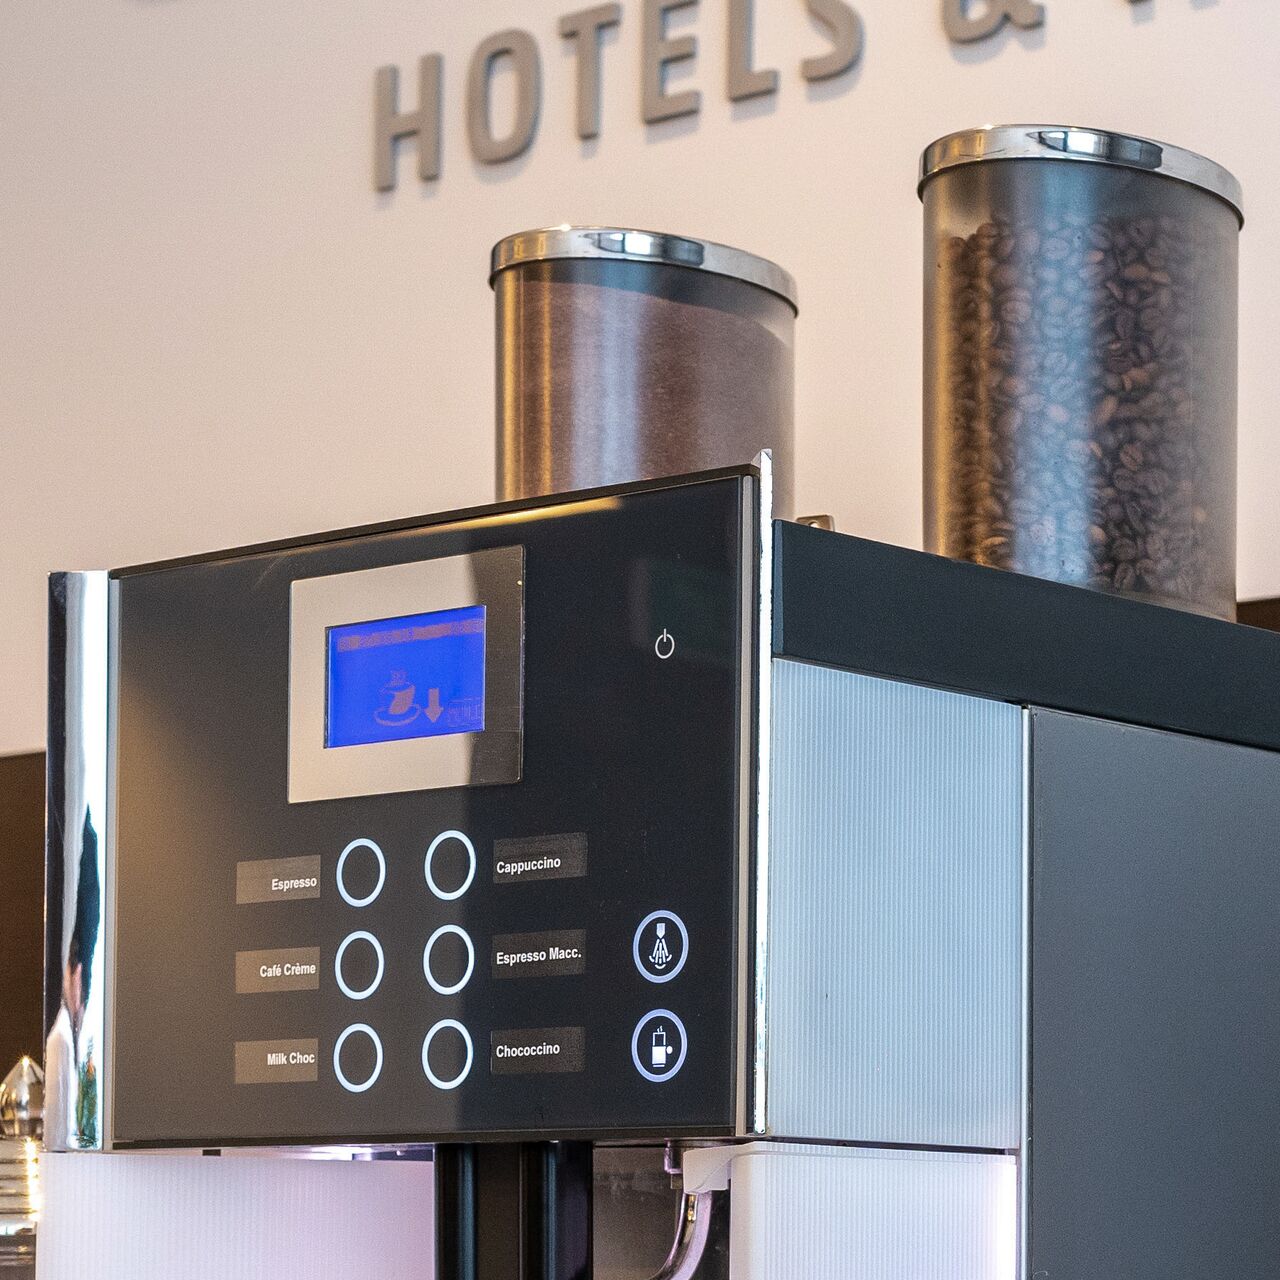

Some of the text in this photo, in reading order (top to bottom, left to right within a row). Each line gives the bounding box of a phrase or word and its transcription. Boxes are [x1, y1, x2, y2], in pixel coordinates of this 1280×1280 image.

[374, 0, 865, 193] HOTELS
[496, 856, 561, 875] Cappuccino
[271, 876, 318, 892] Espresso
[496, 947, 582, 966] Espresso Macc.
[259, 963, 316, 978] Café Crème
[496, 1043, 560, 1058] Chococcino
[267, 1052, 315, 1066] Milk Choc
